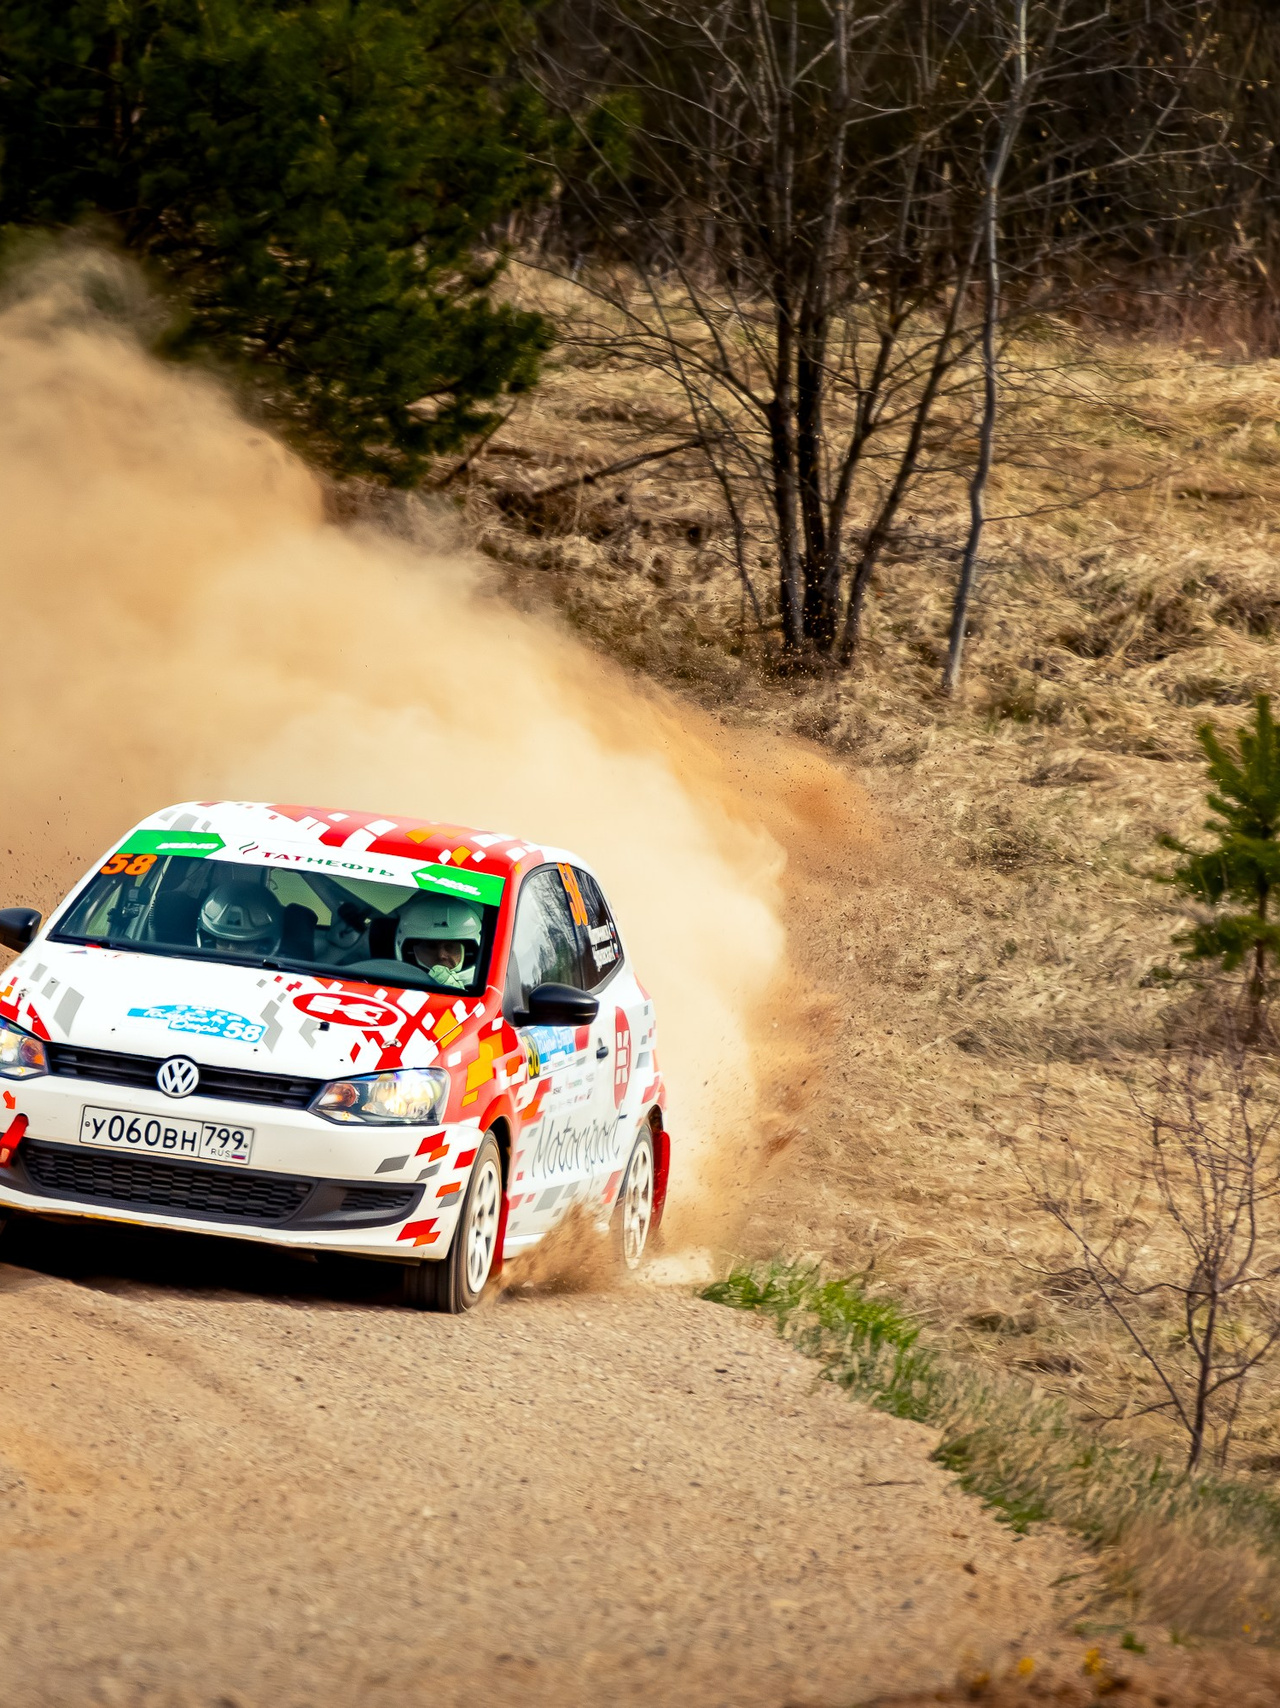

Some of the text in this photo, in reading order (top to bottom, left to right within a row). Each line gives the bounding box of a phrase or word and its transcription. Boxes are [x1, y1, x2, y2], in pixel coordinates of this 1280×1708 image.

[99, 853, 158, 876] 58
[261, 851, 395, 877] ТАТНЕФТЬ
[223, 1021, 262, 1042] 58
[204, 1125, 245, 1151] 799
[531, 1103, 628, 1190] Motorsport
[210, 1148, 231, 1160] RUS
